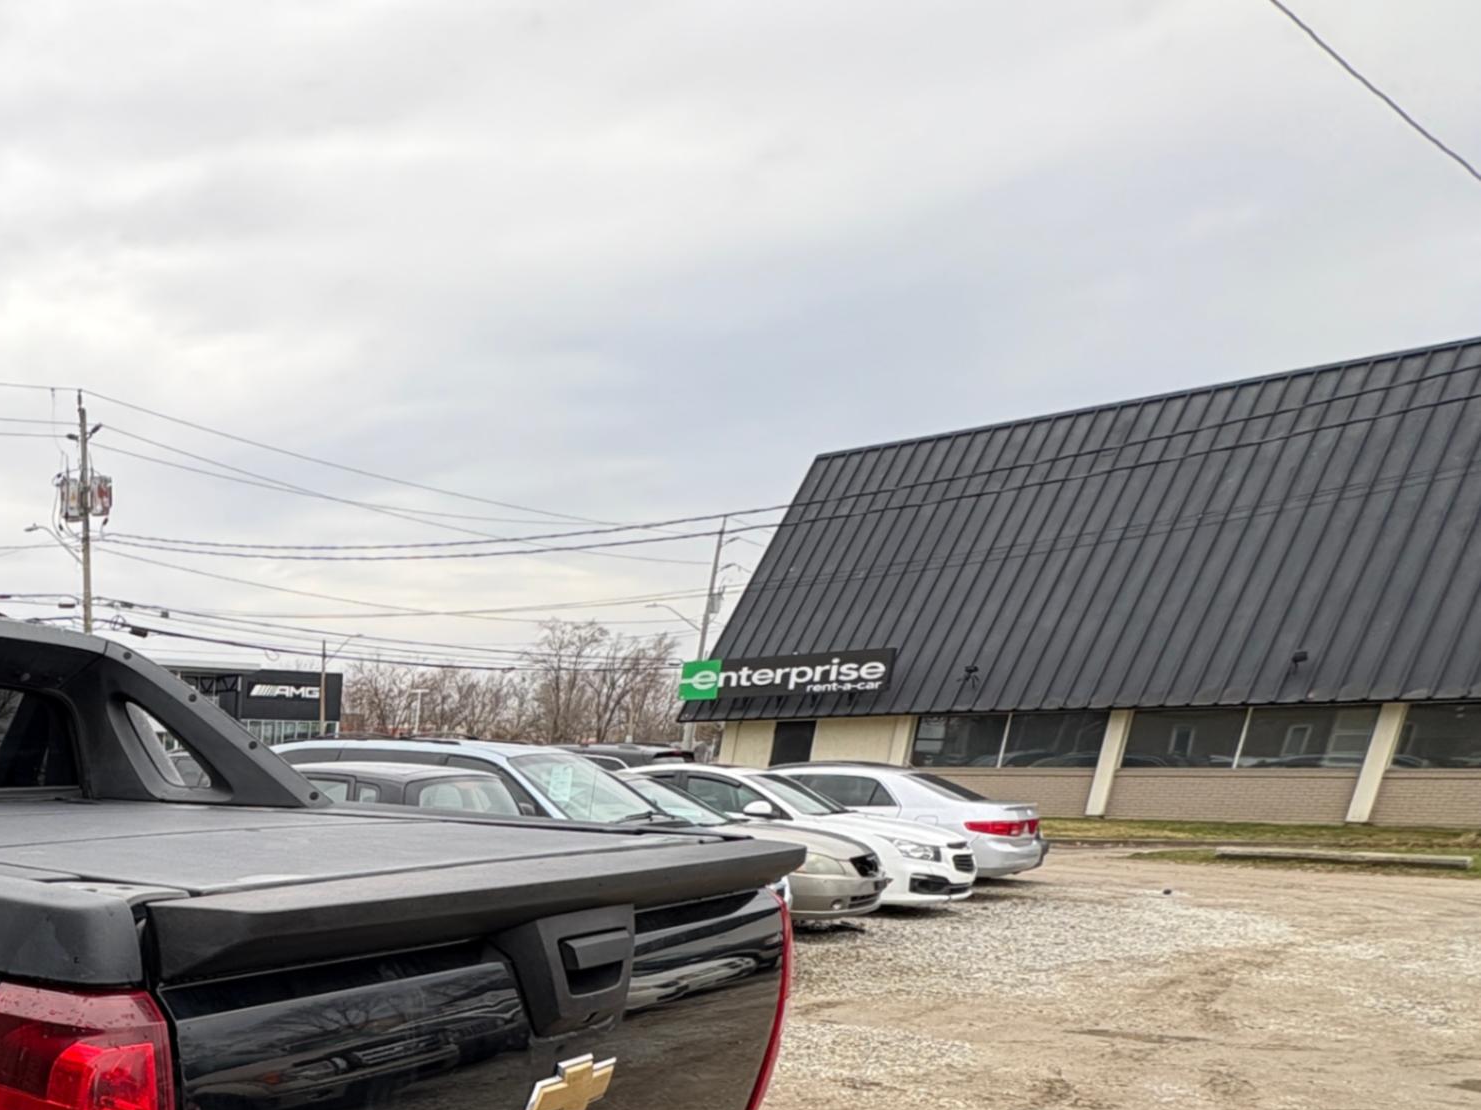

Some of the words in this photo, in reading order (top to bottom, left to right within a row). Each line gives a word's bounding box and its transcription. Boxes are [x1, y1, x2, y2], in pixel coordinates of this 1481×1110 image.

[689, 658, 886, 690] enterprise
[275, 685, 321, 698] AMG
[806, 680, 883, 693] rent-a-car
